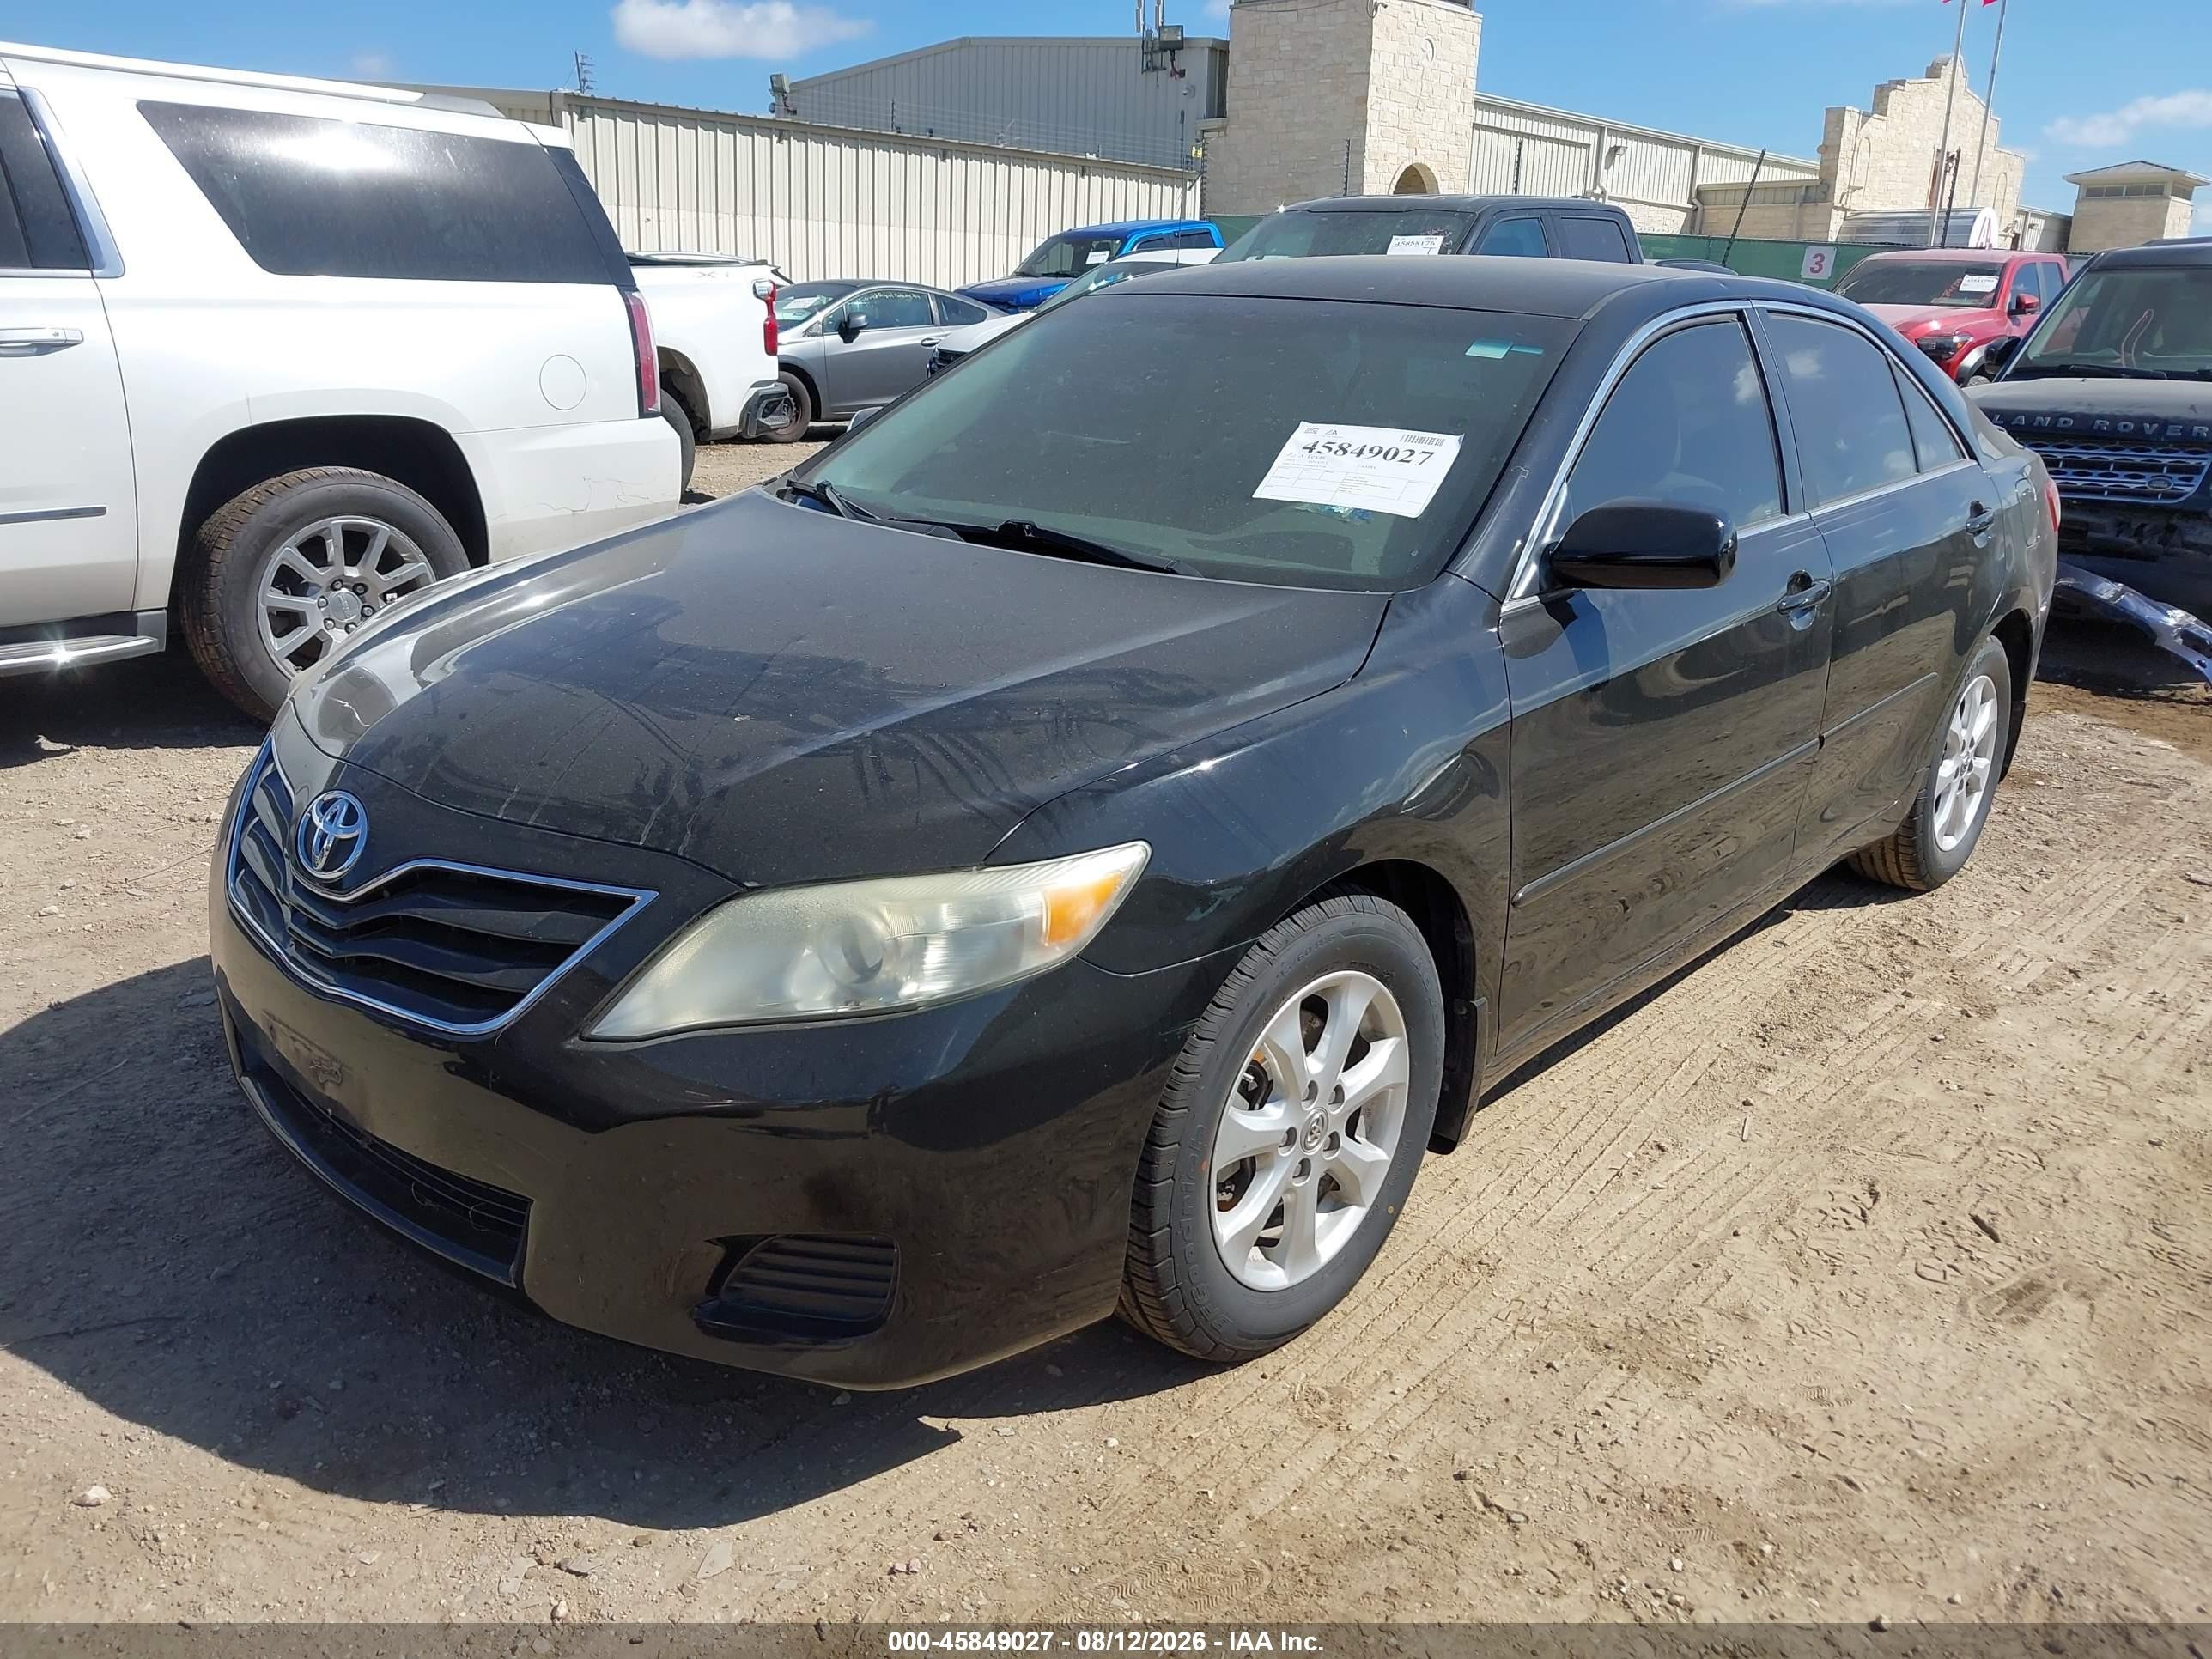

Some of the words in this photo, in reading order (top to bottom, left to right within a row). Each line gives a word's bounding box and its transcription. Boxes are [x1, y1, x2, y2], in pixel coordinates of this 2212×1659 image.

[1809, 252, 1826, 274] 3
[1992, 413, 2074, 428] LAND
[2093, 419, 2209, 438] ROVER
[1302, 440, 1436, 466] 45849027
